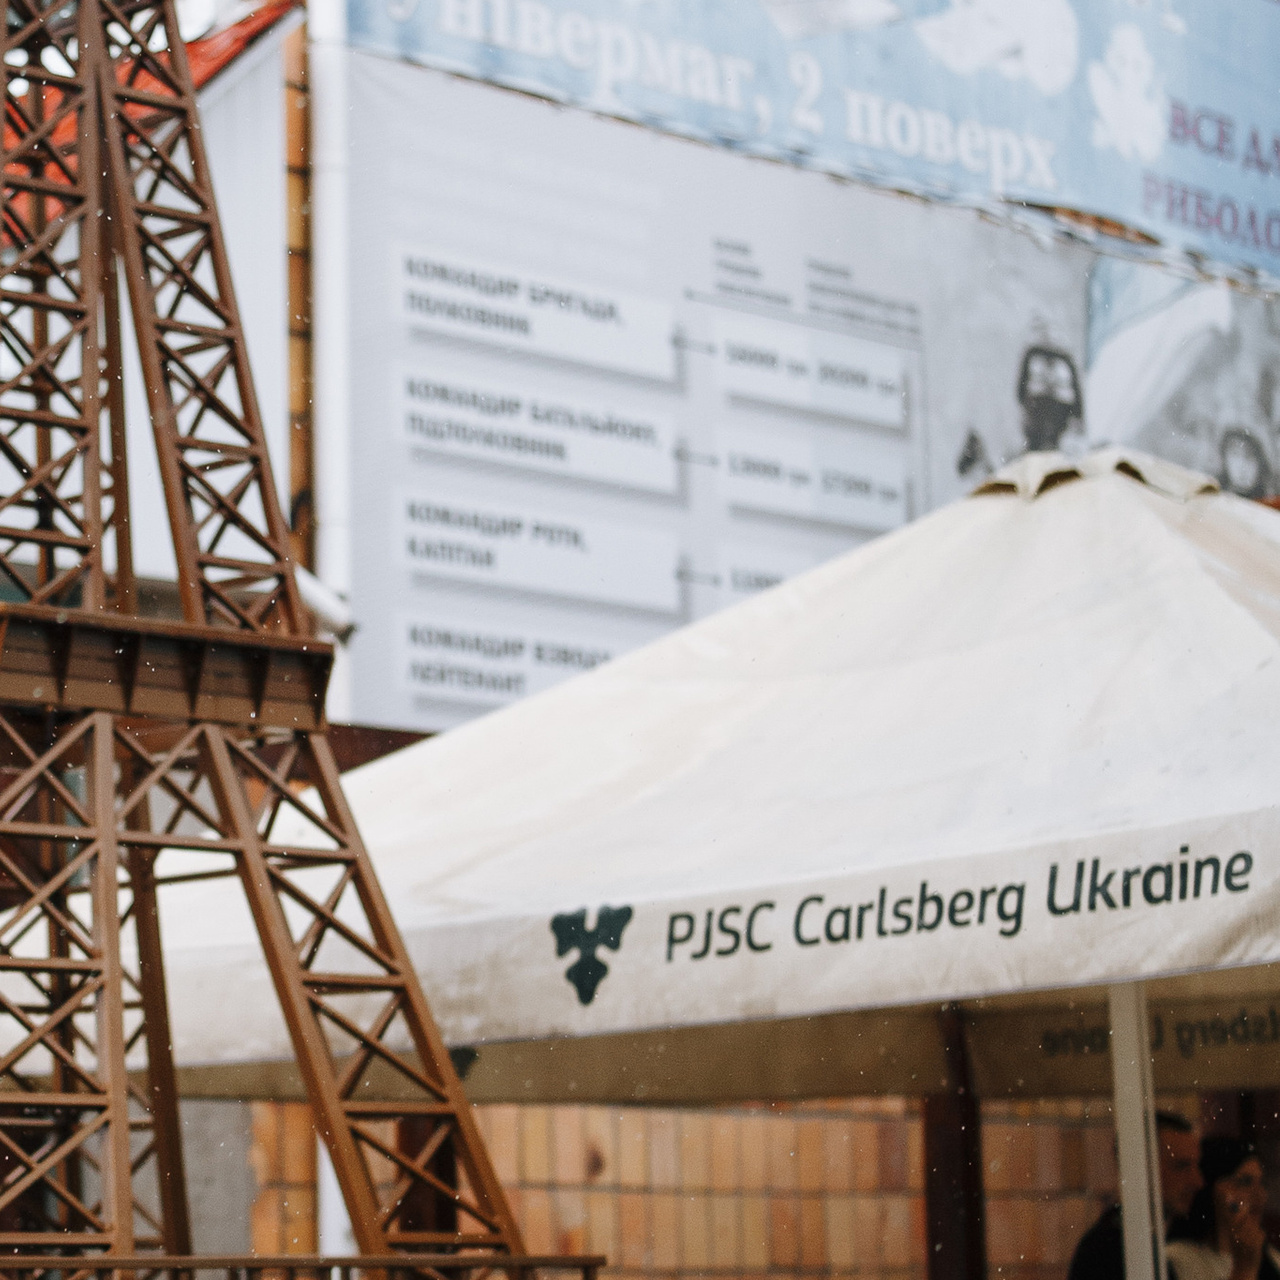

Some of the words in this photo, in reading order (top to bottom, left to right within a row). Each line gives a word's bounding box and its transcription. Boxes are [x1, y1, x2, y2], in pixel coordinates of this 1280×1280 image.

[787, 50, 825, 132] 2
[843, 87, 1058, 201] поверх
[1169, 97, 1235, 163] ВСЕ
[407, 256, 520, 297] КОМАНДИР
[406, 289, 532, 336] ПОЛКОВНИК
[407, 378, 522, 418] КОМАНДИР
[406, 414, 566, 461] ПІДПОЛКОВНИК
[408, 500, 522, 538] КОМАНДИР
[407, 537, 495, 569] КАПІТАН
[409, 626, 525, 660] КОМАНДИР
[410, 661, 524, 693] ЛЕЙТЕНАНТ
[665, 901, 776, 963] PJSC
[792, 880, 1027, 947] Carlsberg
[1045, 844, 1255, 918] Ukraine
